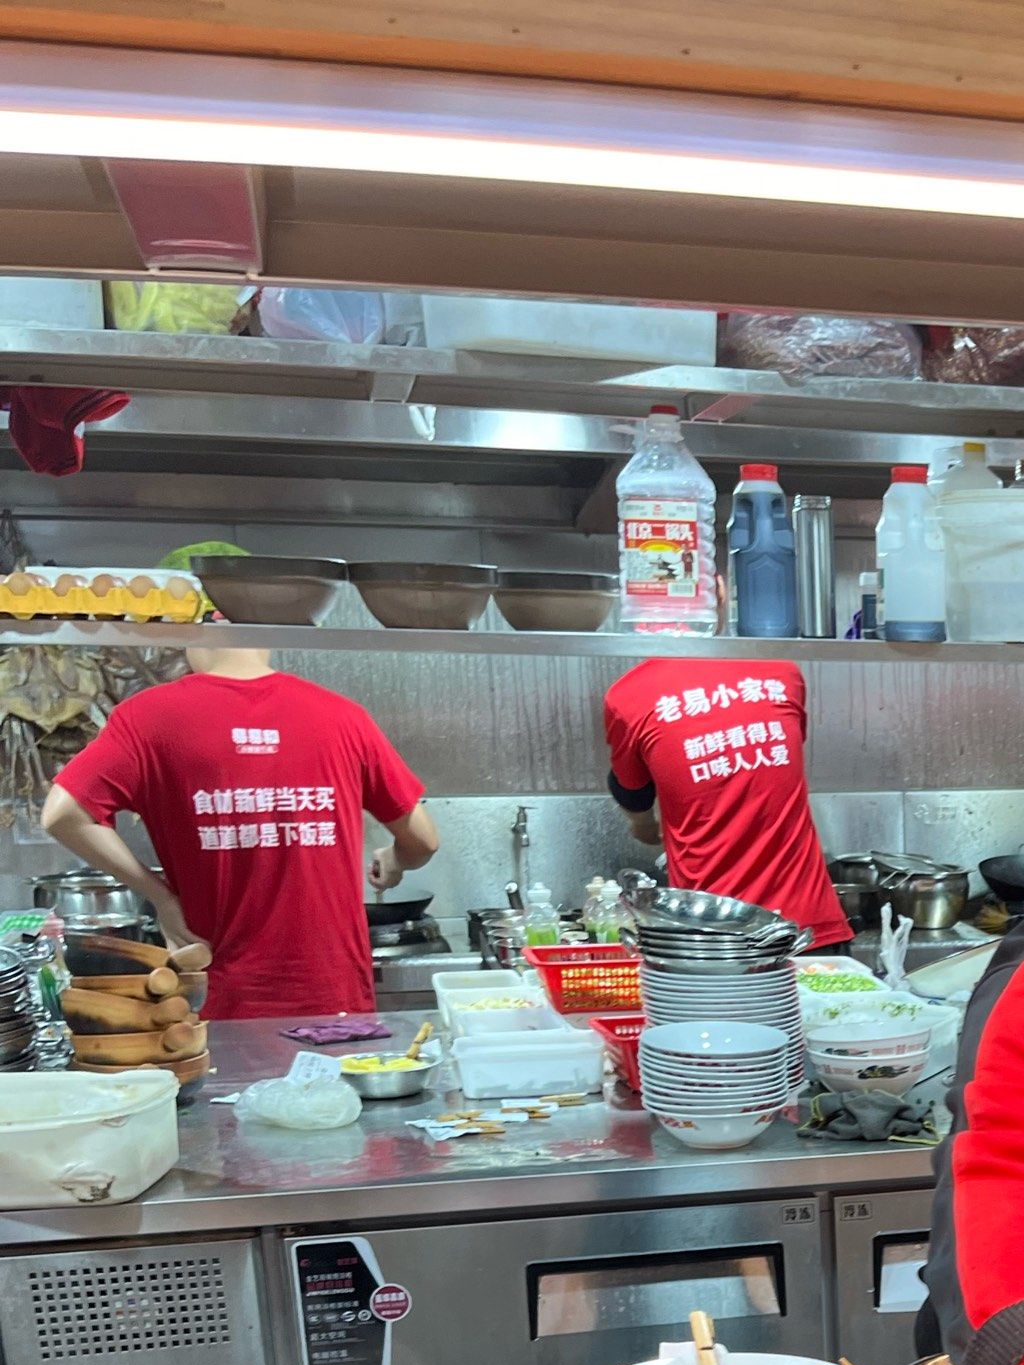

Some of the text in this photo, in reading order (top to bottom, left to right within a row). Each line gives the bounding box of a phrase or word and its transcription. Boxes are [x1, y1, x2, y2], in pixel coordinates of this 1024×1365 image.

[655, 677, 788, 723] 老易小家常
[683, 721, 786, 760] 新鲜看得见
[690, 744, 790, 783] 口味人人爱
[193, 787, 335, 815] 食材新鲜当天买
[198, 822, 336, 850] 道道都是下饭菜
